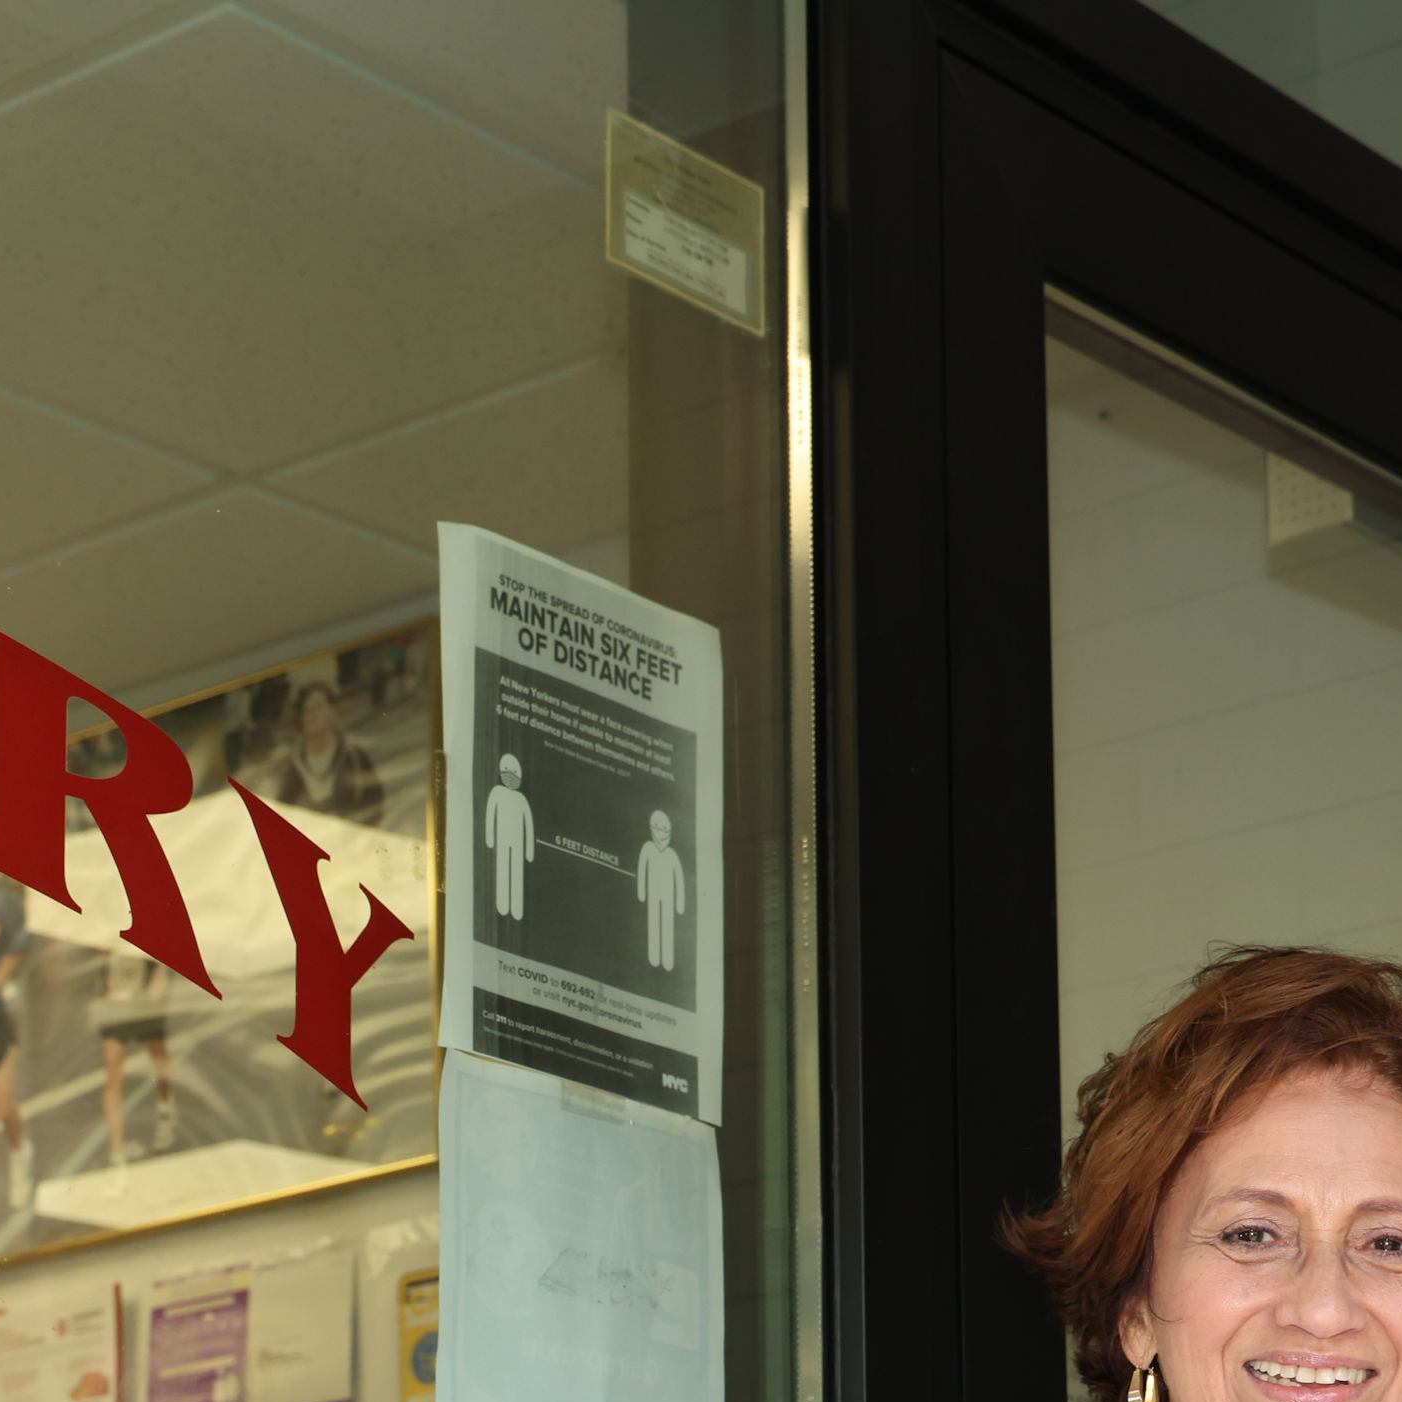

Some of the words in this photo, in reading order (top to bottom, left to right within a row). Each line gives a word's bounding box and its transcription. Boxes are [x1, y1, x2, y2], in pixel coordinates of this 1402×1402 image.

[499, 572, 524, 595] STOP
[528, 585, 547, 604] THE
[549, 593, 588, 622] SPREAD
[592, 612, 604, 628] OF
[490, 584, 594, 651] MAINTAIN
[600, 631, 630, 666] SIX
[636, 647, 682, 688] FEET
[518, 624, 547, 657] OF
[554, 638, 652, 701] DISTANCE
[501, 691, 529, 711] outside
[511, 679, 529, 695] New
[530, 687, 559, 707] Yorkers
[503, 707, 518, 722] feet
[520, 712, 529, 725] of
[529, 717, 561, 738] distance
[562, 730, 593, 750] between
[555, 834, 560, 845] 6
[562, 837, 580, 852] FEET
[582, 843, 619, 866] DISTANCE
[498, 960, 515, 974] Text
[517, 966, 547, 985] COVID
[549, 976, 558, 988] to
[560, 980, 595, 1000] 692-692
[532, 986, 540, 996] or
[544, 989, 559, 1002] visit
[482, 1009, 494, 1020] Call
[662, 1072, 688, 1094] NYC
